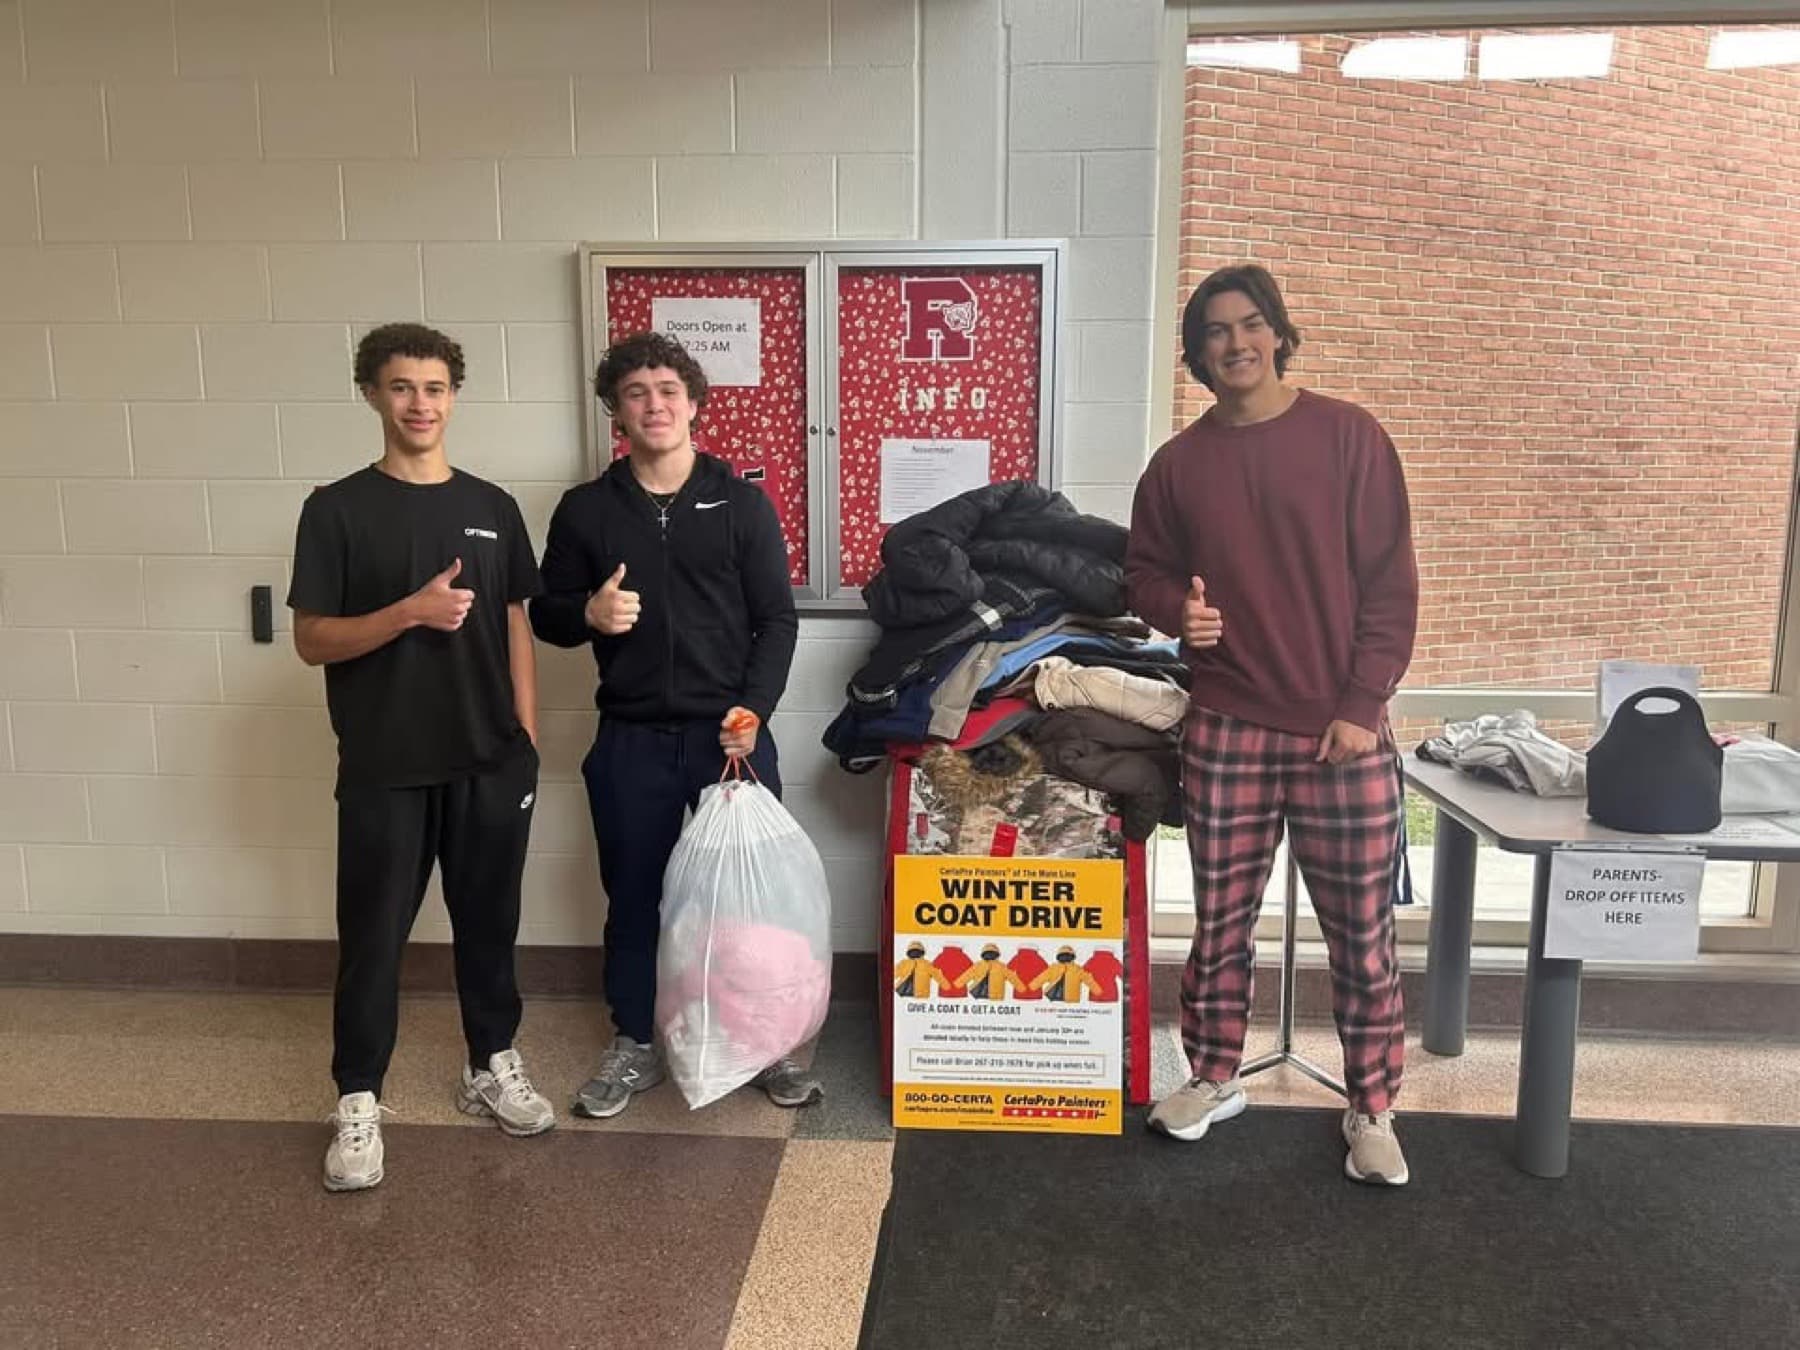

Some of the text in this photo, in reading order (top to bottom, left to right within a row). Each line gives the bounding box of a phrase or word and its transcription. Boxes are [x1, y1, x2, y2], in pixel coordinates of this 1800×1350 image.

[666, 320, 747, 333] Doors Open at
[710, 341, 730, 352] AM
[899, 387, 987, 411] INFO
[1012, 868, 1020, 877] of
[1023, 868, 1037, 878] The
[1059, 869, 1077, 879] Line
[1592, 868, 1663, 881] PARENTS-
[941, 878, 1075, 901] WINTER
[1565, 889, 1685, 905] DROP OFF ITEMS
[915, 903, 1103, 929] COAT DRIVE
[1604, 912, 1643, 925] HERE
[907, 1003, 926, 1013] GIVE
[928, 1004, 935, 1013] A
[937, 1004, 960, 1014] COAT
[971, 1004, 988, 1015] GET
[989, 1005, 996, 1015] A
[997, 1006, 1021, 1016] COAT
[905, 1092, 1106, 1108] 800-GO-CERTA CertaPro Painters
